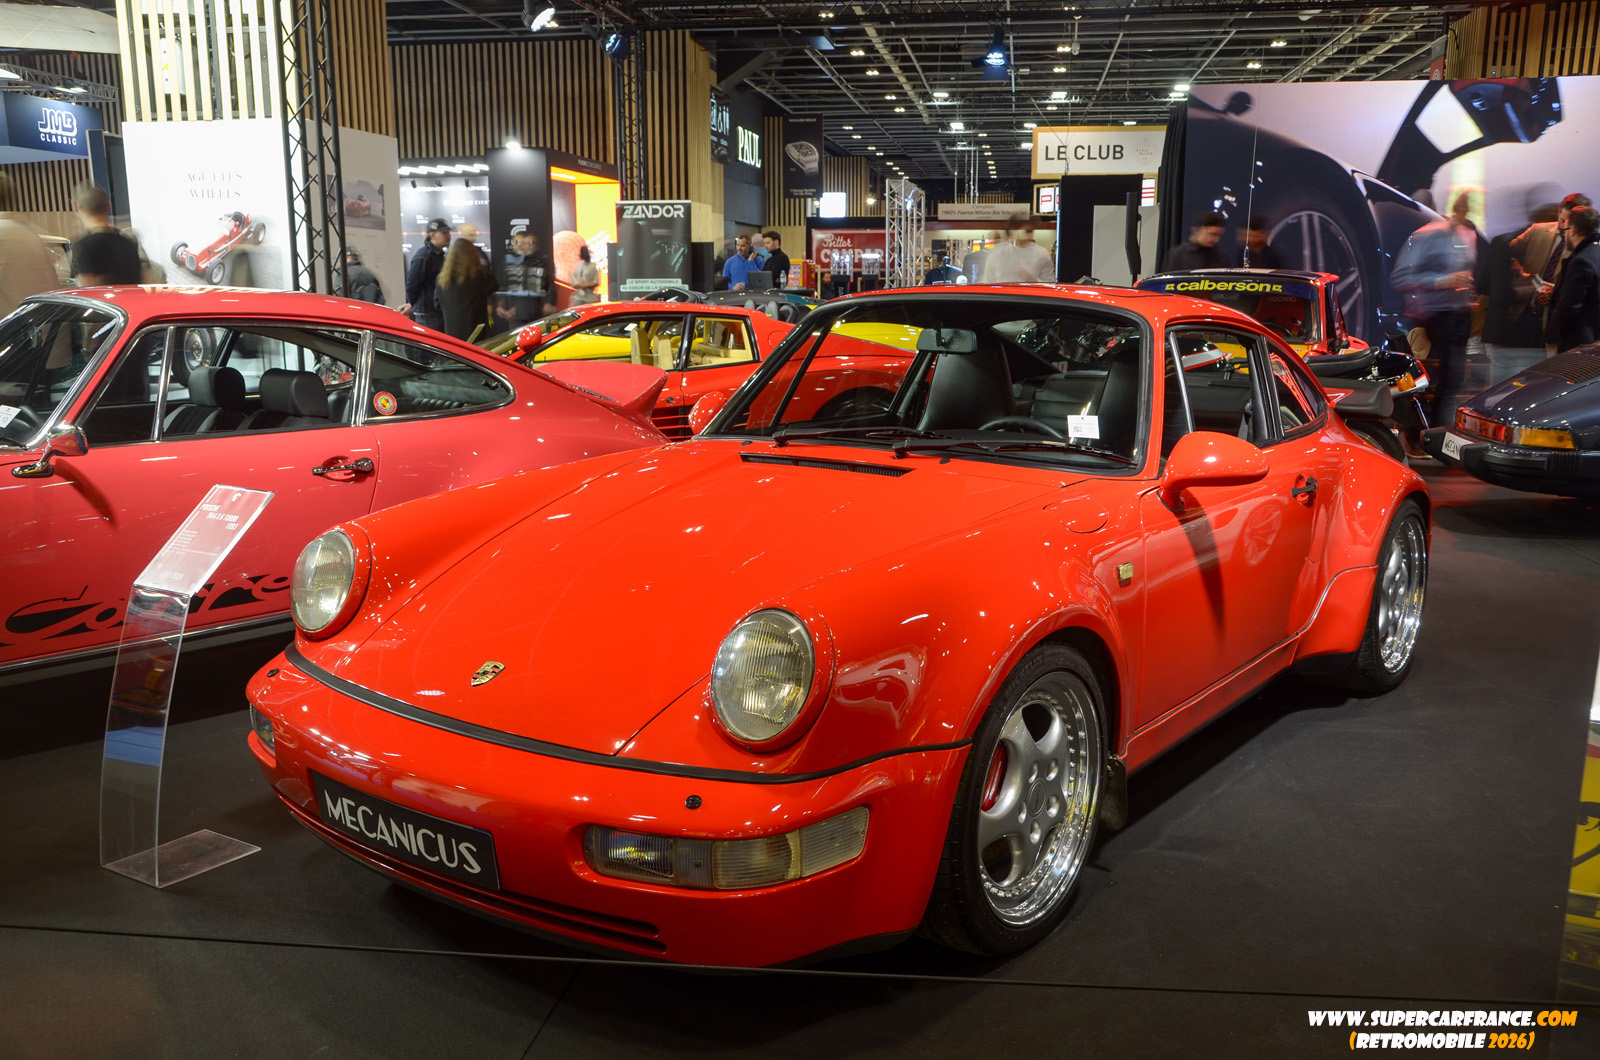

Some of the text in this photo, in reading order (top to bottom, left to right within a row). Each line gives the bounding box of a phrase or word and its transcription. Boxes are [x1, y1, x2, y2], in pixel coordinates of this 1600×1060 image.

[38, 107, 77, 137] JMB
[40, 132, 78, 146] CLASSIC
[737, 125, 762, 168] PAUL
[1045, 145, 1068, 160] LE
[1074, 144, 1125, 160] CLUB
[622, 204, 685, 218] ZANDOR
[823, 233, 853, 247] Bitter
[1177, 279, 1271, 292] calberson
[323, 789, 482, 874] MECANICUS
